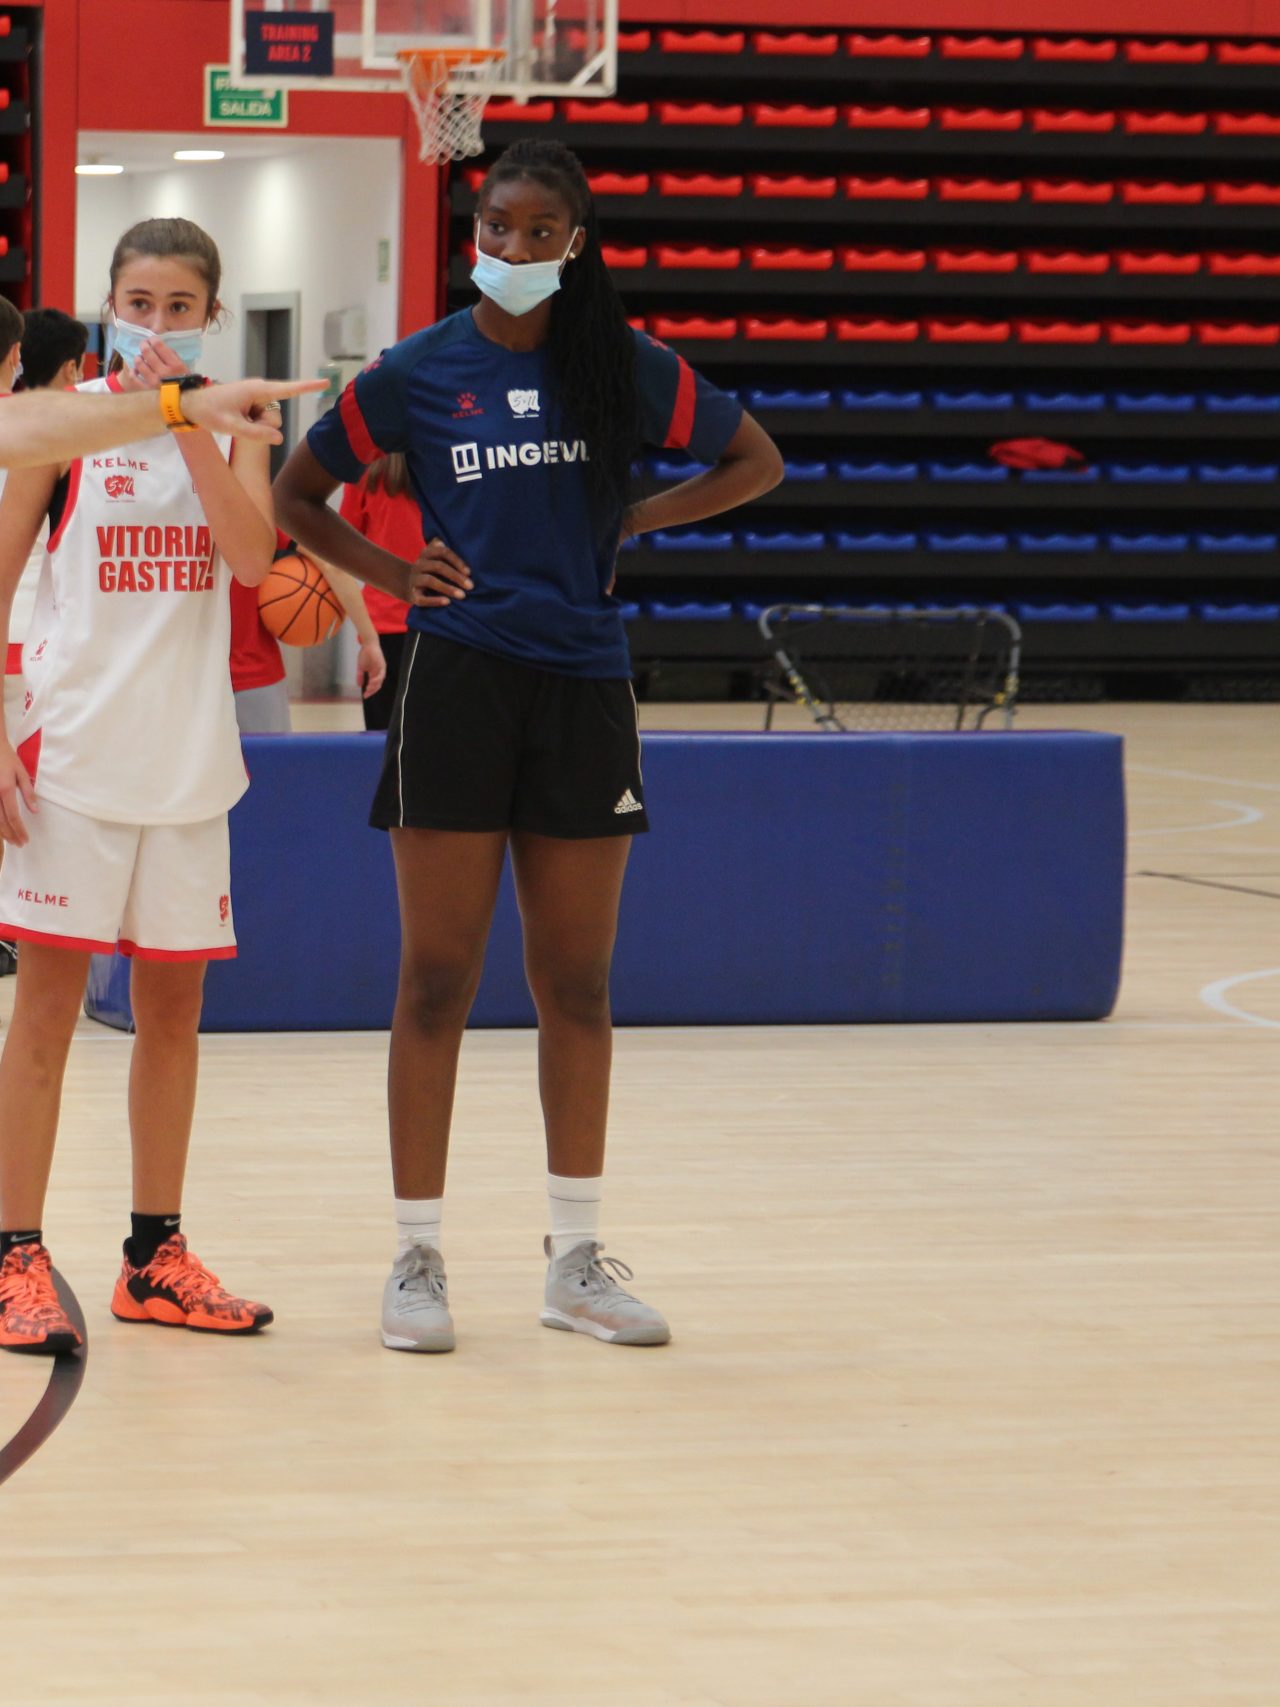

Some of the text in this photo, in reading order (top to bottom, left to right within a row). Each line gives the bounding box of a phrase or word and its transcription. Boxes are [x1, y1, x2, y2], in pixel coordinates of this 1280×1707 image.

[260, 24, 319, 42] TRAINING
[267, 45, 312, 62] AREA 2
[220, 101, 272, 116] SALIDA
[92, 456, 149, 472] KELME
[96, 525, 211, 558] VITORIA
[98, 560, 214, 593] GASTEIZ
[614, 801, 643, 814] adidas
[17, 888, 70, 908] KELME
